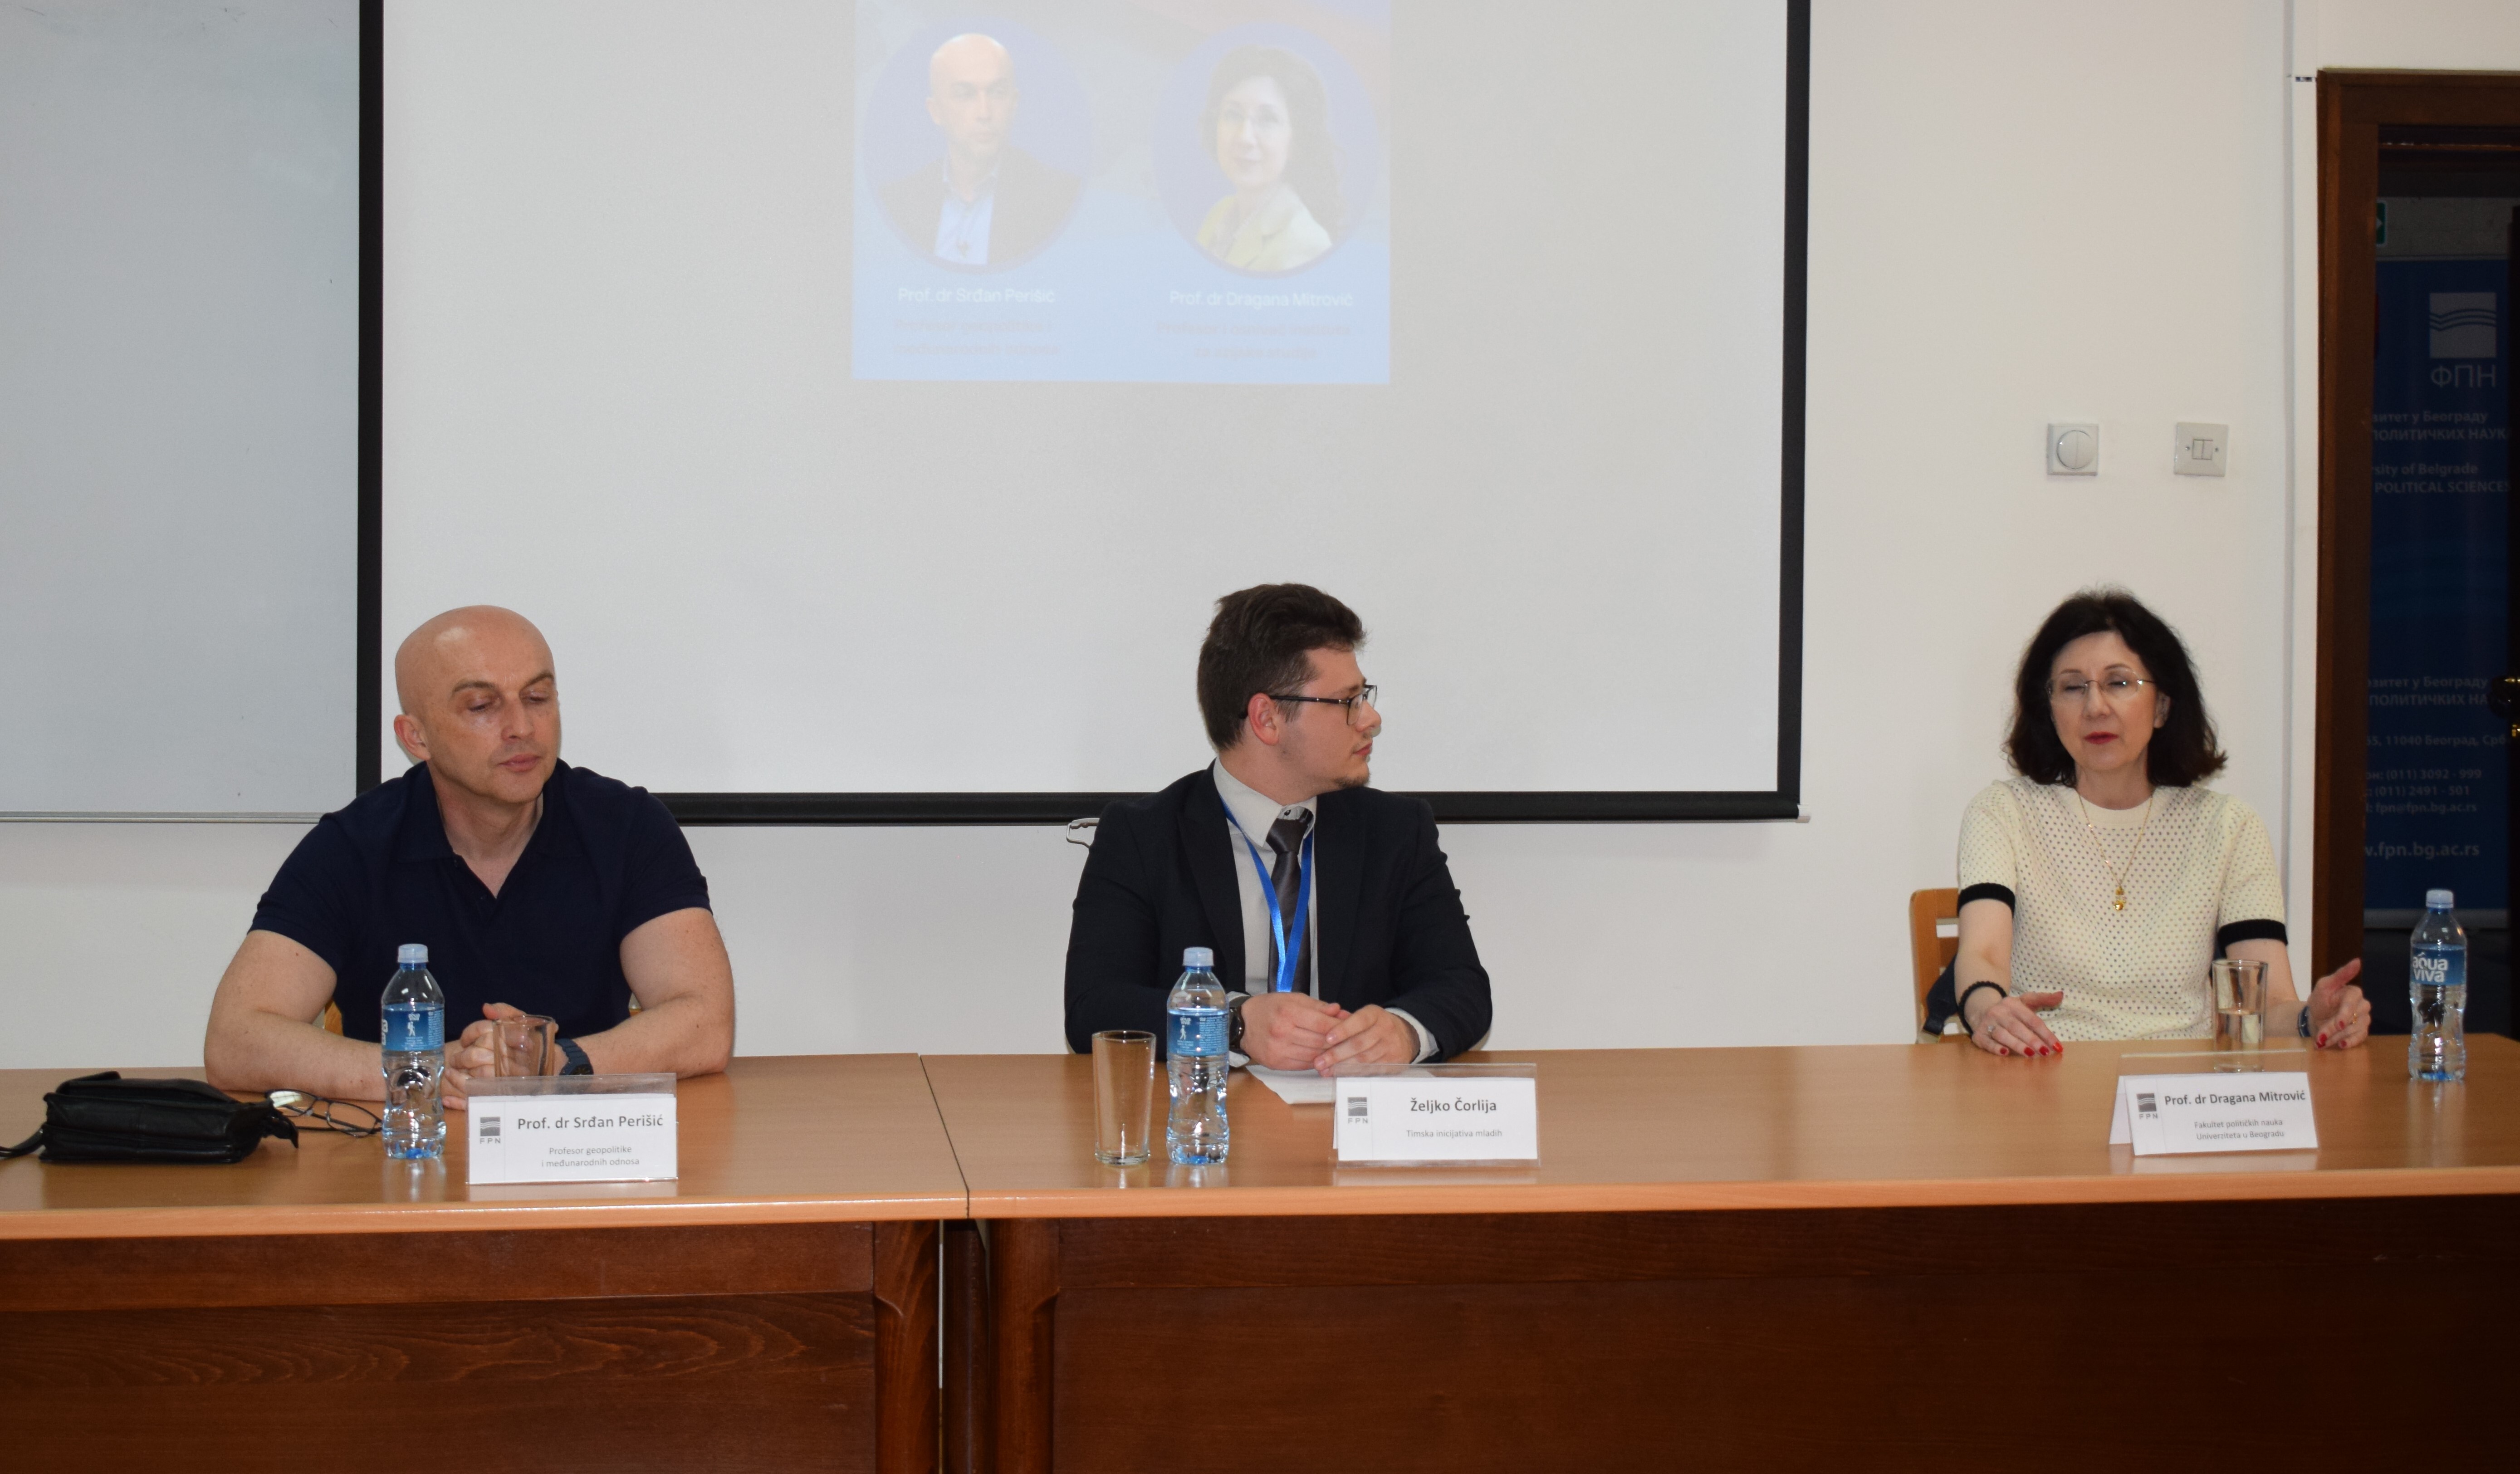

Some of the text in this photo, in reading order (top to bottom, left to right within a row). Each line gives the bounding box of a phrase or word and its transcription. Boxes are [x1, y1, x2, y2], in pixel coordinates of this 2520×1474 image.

[898, 288, 1056, 303] Prof. dr Srđan Perišić
[1169, 290, 1353, 310] Prof. dr Dragana Mitrović
[2430, 364, 2496, 388] ФПН
[2412, 413, 2420, 425] у
[2423, 411, 2488, 424] Београду
[2401, 463, 2416, 475] of
[2418, 463, 2478, 477] Belgrade
[2374, 481, 2444, 494] POLITICAL
[2412, 678, 2420, 690] у
[2423, 676, 2488, 690] Београду
[2369, 694, 2466, 706] ПОЛИТИЧКИХ
[2386, 735, 2422, 745] 11040
[2386, 769, 2417, 781] (011)
[2419, 769, 2449, 779] 3092
[2459, 769, 2482, 779] 999
[2375, 785, 2406, 797] (011)
[2409, 785, 2437, 796] 2491
[2448, 785, 2471, 796] 501
[2375, 801, 2477, 815] fpn@fpn.bg.ac.rs
[2413, 969, 2445, 983] viva
[2164, 1090, 2306, 1106] Prof. dr Dragana Mitrović
[1410, 1097, 1497, 1114] Željko Čorlija
[518, 1113, 664, 1129] Prof. dr Srđan Perišić
[2194, 1121, 2224, 1129] Fakultet
[2226, 1119, 2259, 1130] političkih
[1436, 1129, 1473, 1139] inicijativa
[1475, 1129, 1503, 1137] mladih
[2196, 1131, 2241, 1140] Univerziteta
[2249, 1130, 2285, 1139] Beogradu
[549, 1146, 632, 1156] Profesor geopolitike
[546, 1158, 607, 1167] međunarodnih
[610, 1157, 640, 1165] odnosa
